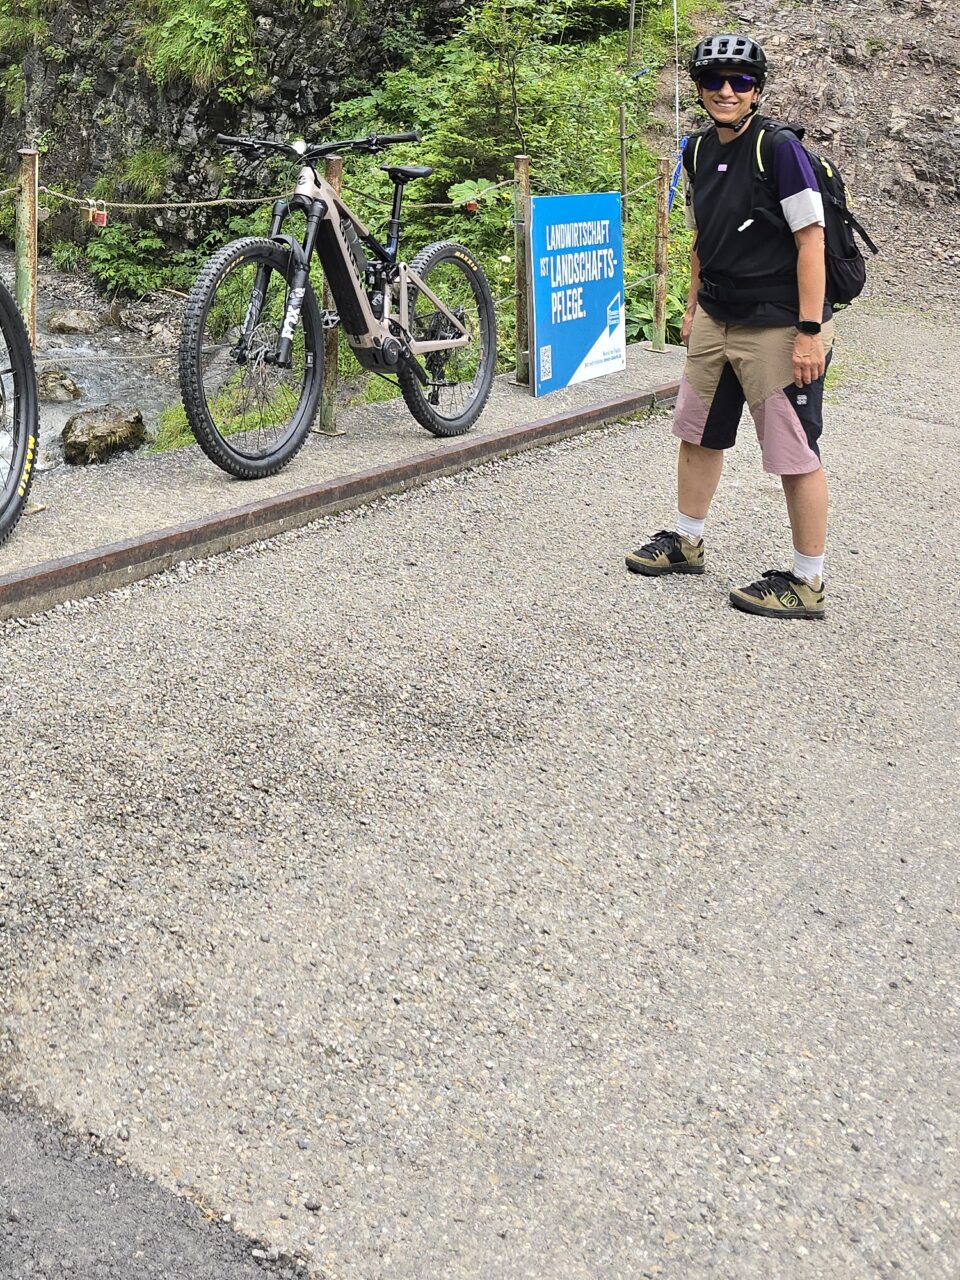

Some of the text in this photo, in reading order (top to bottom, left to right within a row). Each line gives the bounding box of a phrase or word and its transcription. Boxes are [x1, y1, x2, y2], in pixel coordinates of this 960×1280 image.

[546, 220, 610, 251] LANDWIRTSCHAFT
[540, 248, 617, 288] IST LANDSCHAFTS-
[551, 288, 587, 325] PFLEGE.
